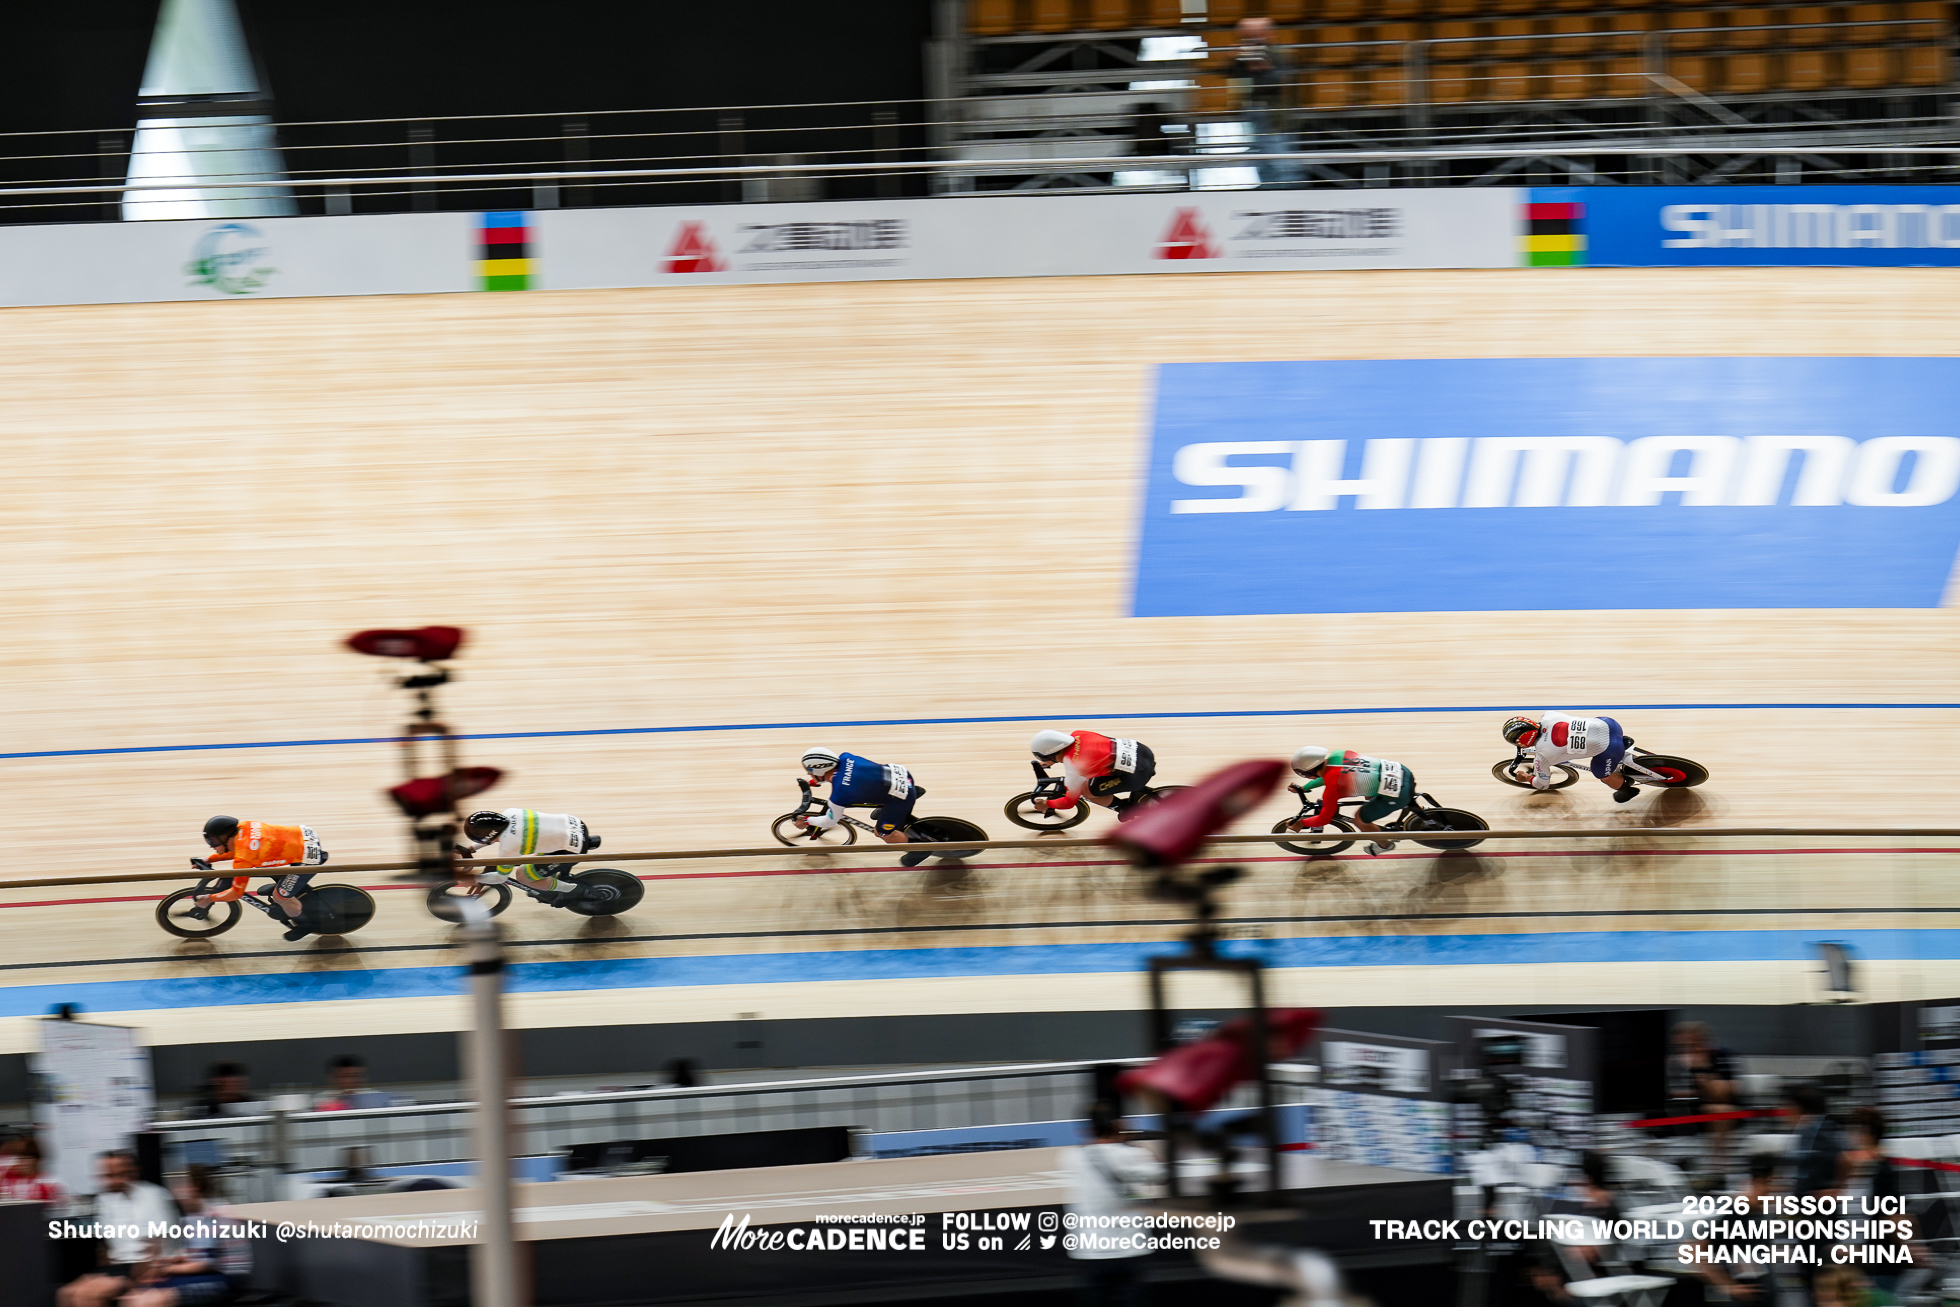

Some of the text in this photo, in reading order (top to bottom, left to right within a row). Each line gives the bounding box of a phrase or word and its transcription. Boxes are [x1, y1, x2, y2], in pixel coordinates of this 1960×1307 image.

[1170, 435, 1960, 515] SHIMANO
[1072, 735, 1081, 762] CHINA
[1569, 735, 1586, 750] 168
[842, 758, 855, 786] FRANCE
